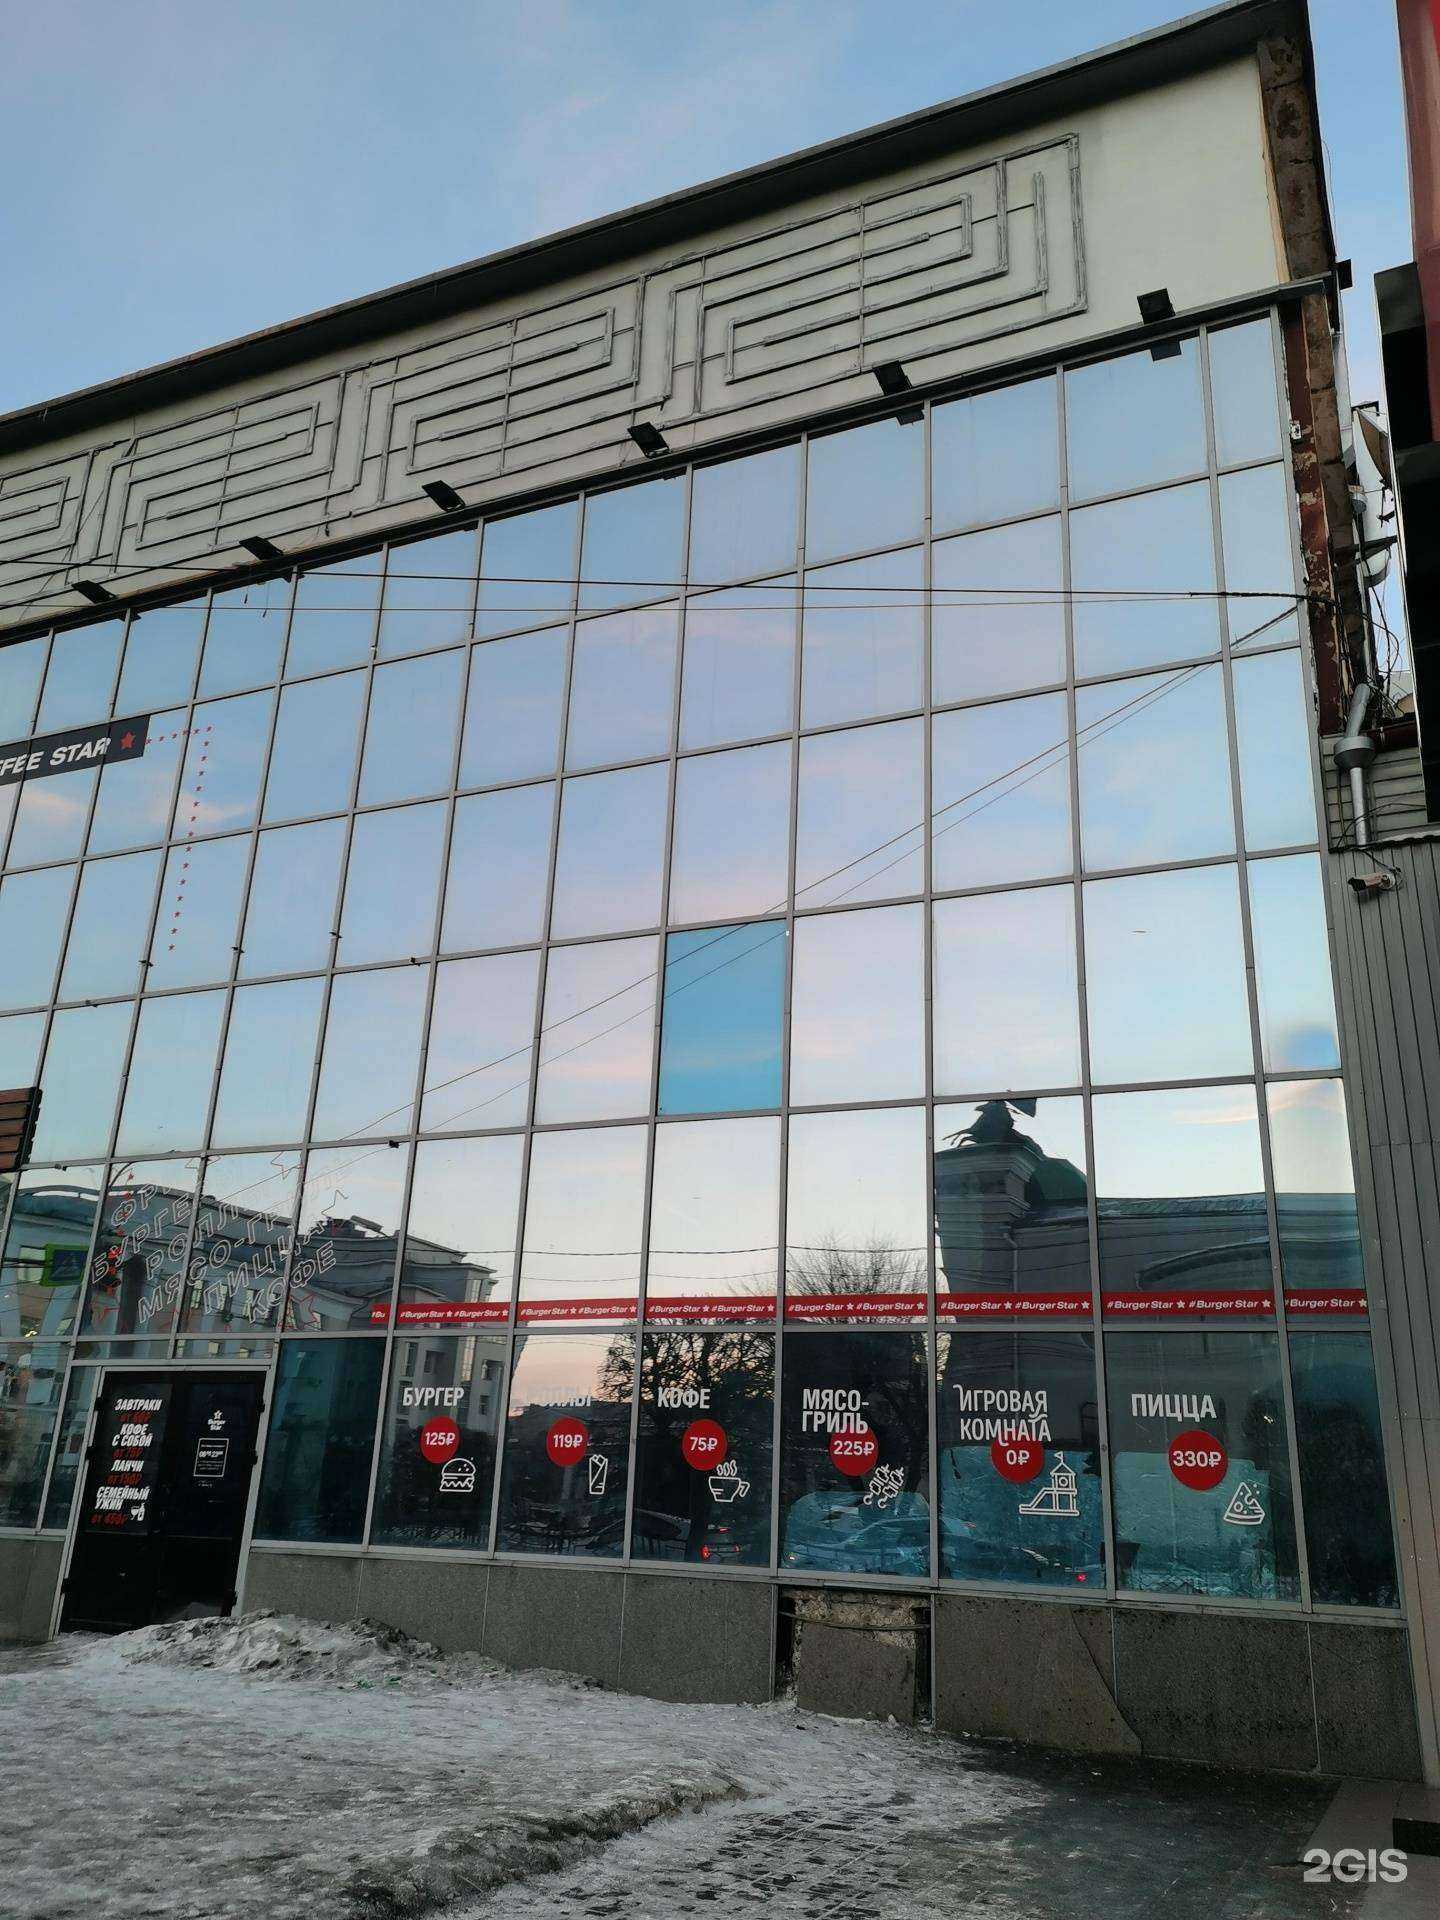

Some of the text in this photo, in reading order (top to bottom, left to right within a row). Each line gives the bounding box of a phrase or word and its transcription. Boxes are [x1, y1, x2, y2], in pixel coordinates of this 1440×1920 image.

[49, 737, 112, 766] STAR
[249, 1240, 337, 1324] КОФЕ
[114, 1399, 163, 1411] ЗАВТРАКИ
[402, 1386, 465, 1407] БУРГЕР
[657, 1386, 711, 1409] КОФЕ
[802, 1388, 870, 1411] МЯСО-
[953, 1384, 1048, 1420] ИГРОВАЯ
[1131, 1393, 1217, 1422] ПИЦЦА
[120, 1423, 149, 1435] КОФЕ
[802, 1411, 869, 1434] ГРИЛЬ
[111, 1432, 154, 1447] С СОБОЙ
[425, 1432, 456, 1447] 125₽
[960, 1417, 1052, 1446] КОМНАТА
[553, 1434, 583, 1448] 119₽
[689, 1436, 718, 1451] 75₽
[833, 1440, 875, 1456] 225₽
[111, 1459, 144, 1472] ЛАНЧИ
[1006, 1449, 1030, 1466] 0₽
[1173, 1450, 1222, 1467] 330₽
[96, 1485, 151, 1501] СЕМЕЙНЫЙ
[94, 1498, 125, 1511] УЖИН
